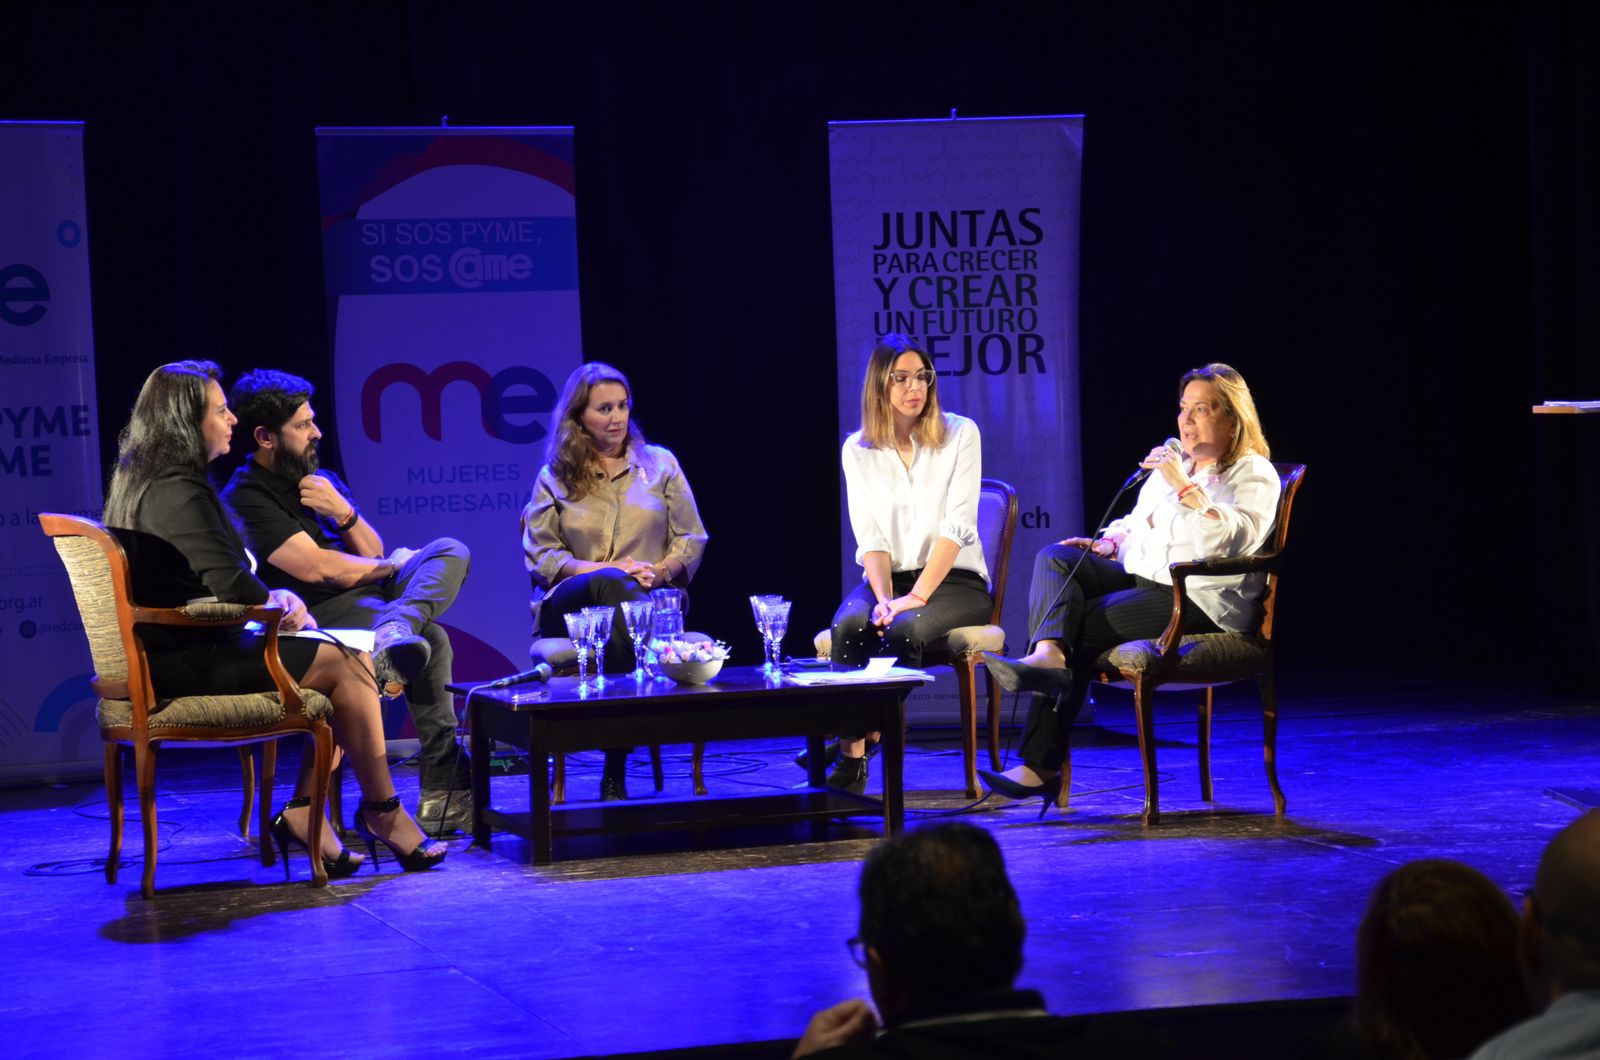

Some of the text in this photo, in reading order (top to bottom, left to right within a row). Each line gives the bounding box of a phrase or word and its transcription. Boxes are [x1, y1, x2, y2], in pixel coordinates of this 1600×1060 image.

[362, 221, 541, 245] SI SOS PYME,
[873, 208, 1044, 250] JUNTAS
[369, 254, 444, 283] SOS
[873, 249, 1038, 274] PARA CRECER
[873, 273, 1038, 310] Y CREAR
[874, 307, 1038, 336] UN FUTURO
[876, 333, 1046, 377] EJOR
[361, 361, 558, 445] me
[0, 405, 90, 438] YME
[407, 463, 521, 485] MUJERES
[1021, 505, 1050, 529] ch
